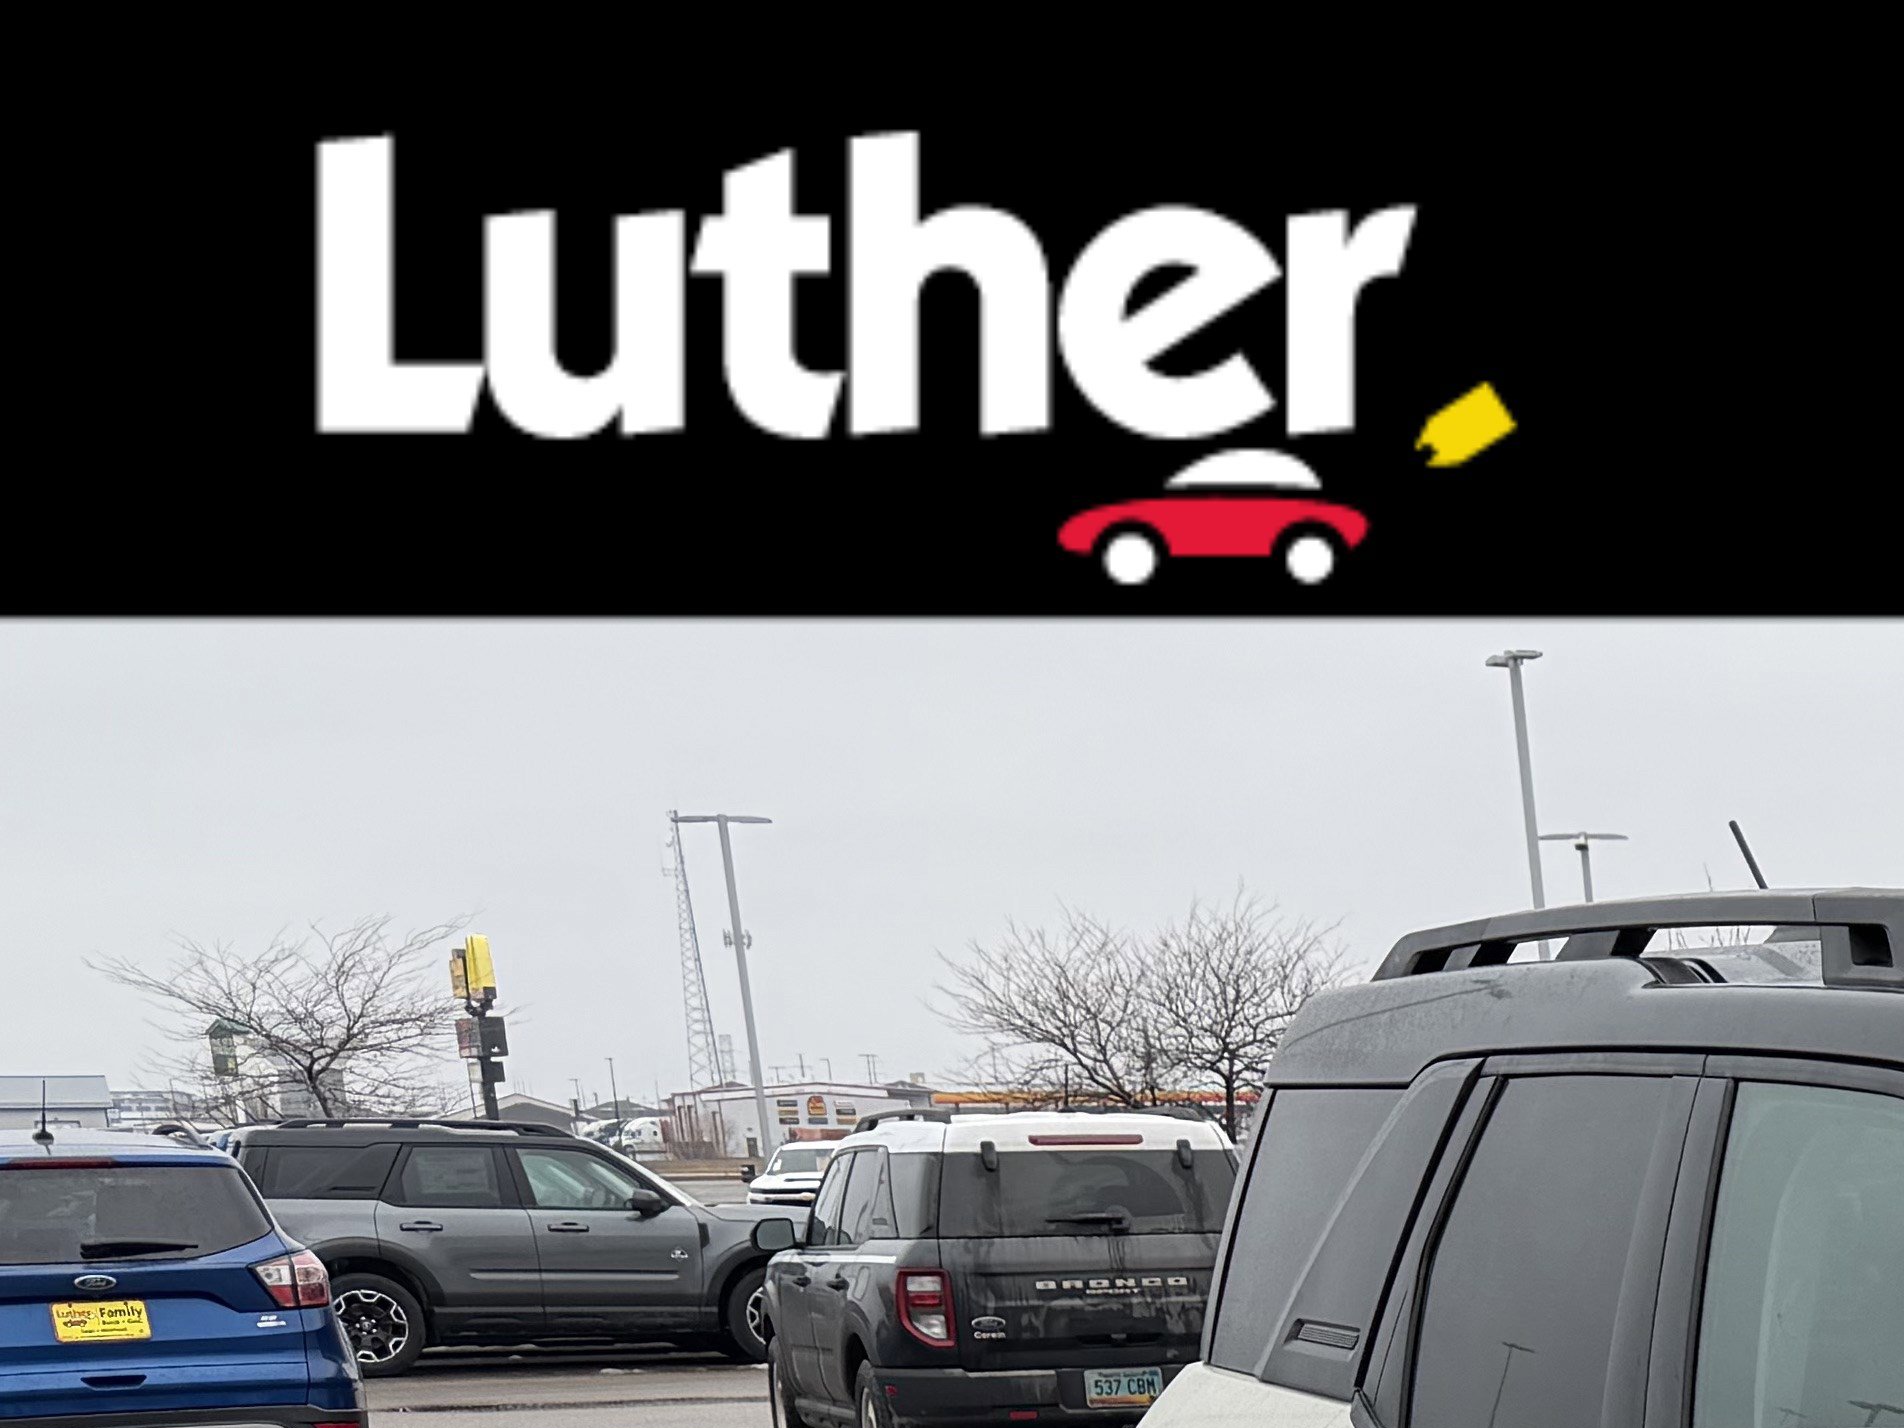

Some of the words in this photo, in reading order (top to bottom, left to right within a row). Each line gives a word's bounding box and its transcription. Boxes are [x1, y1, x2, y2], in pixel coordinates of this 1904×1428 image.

[1035, 1276, 1188, 1290] BRONCO
[99, 1304, 143, 1319] Family
[1094, 1379, 1121, 1396] 537
